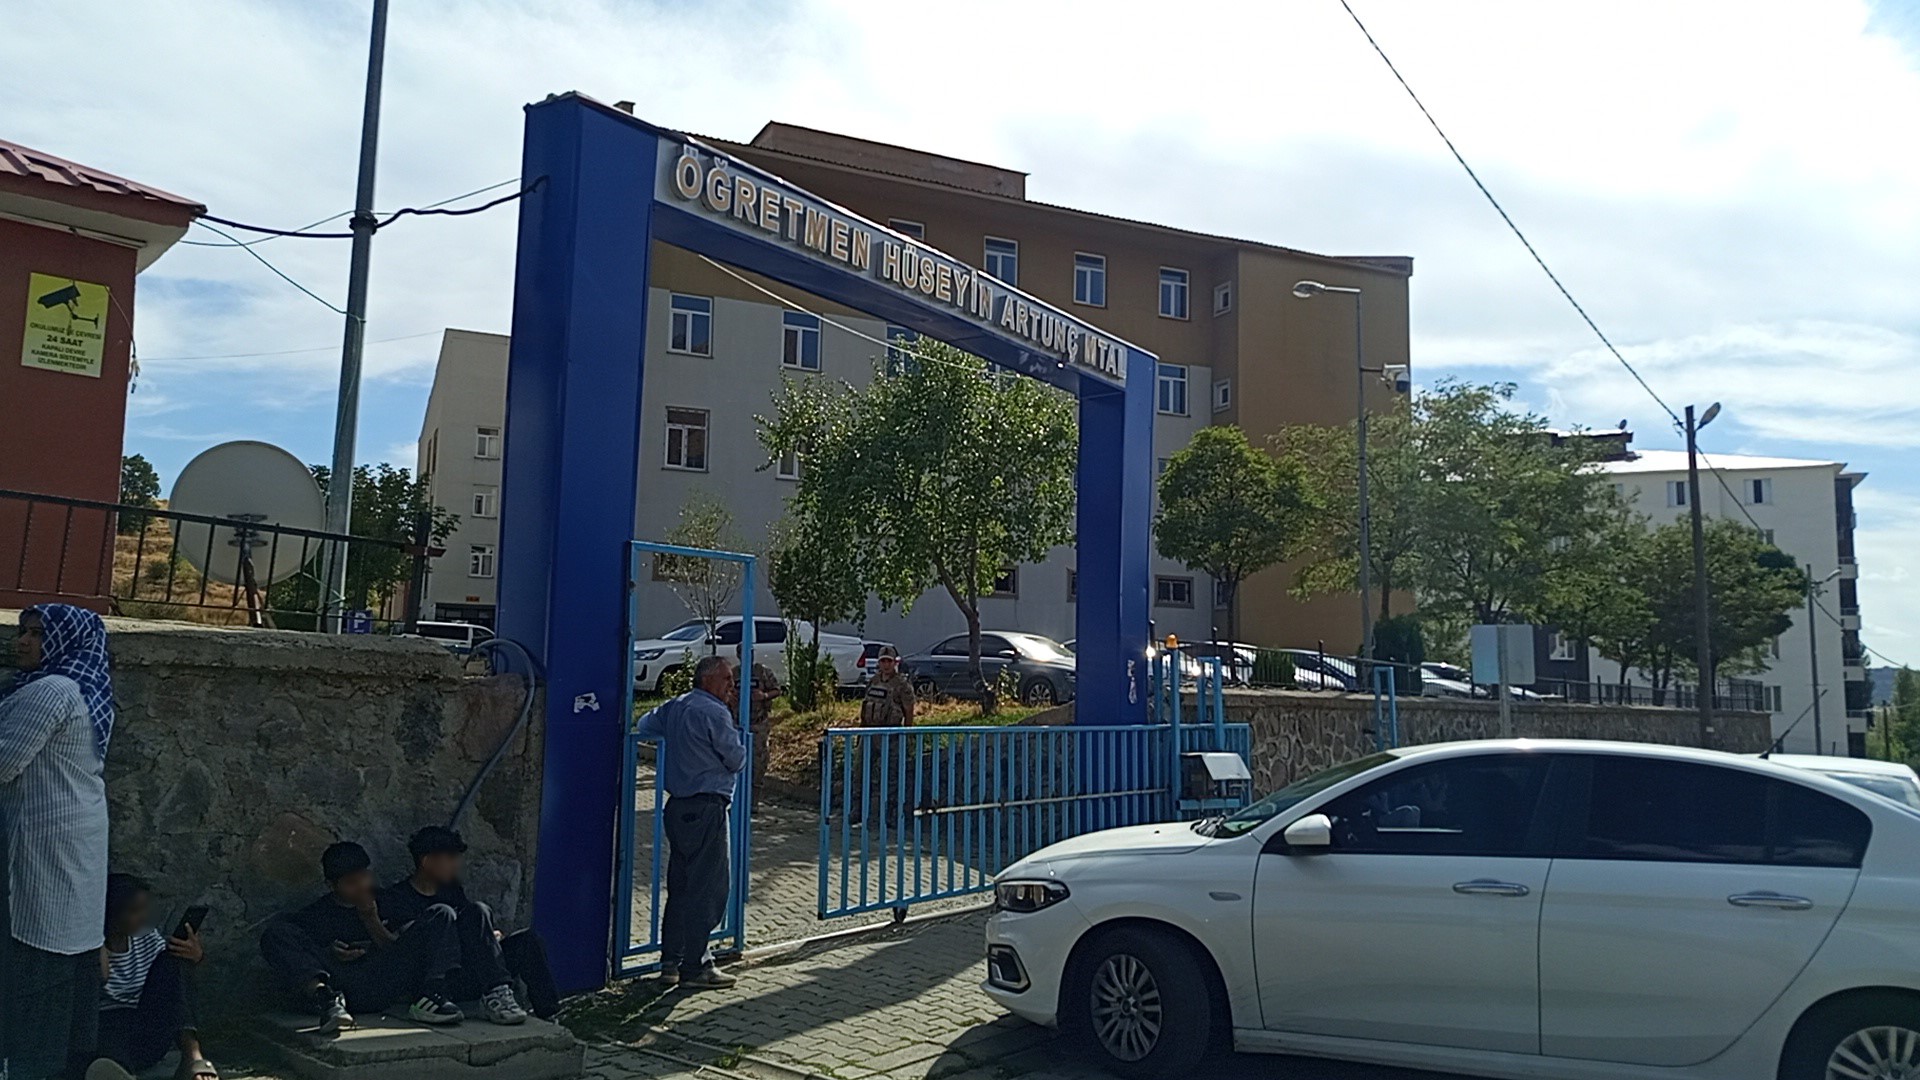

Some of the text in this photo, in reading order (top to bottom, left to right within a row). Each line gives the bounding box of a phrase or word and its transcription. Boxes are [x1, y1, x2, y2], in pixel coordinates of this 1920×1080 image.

[676, 144, 872, 270] ÖĞRETMEN
[883, 240, 993, 321] HÜSEYİN
[1001, 295, 1079, 362] ARTUNÇ
[30, 322, 65, 334] OKULUMUZ
[46, 334, 84, 347] 24 SAAT
[31, 349, 58, 358] KAMERA
[41, 344, 86, 356] KAPALI DEVRE
